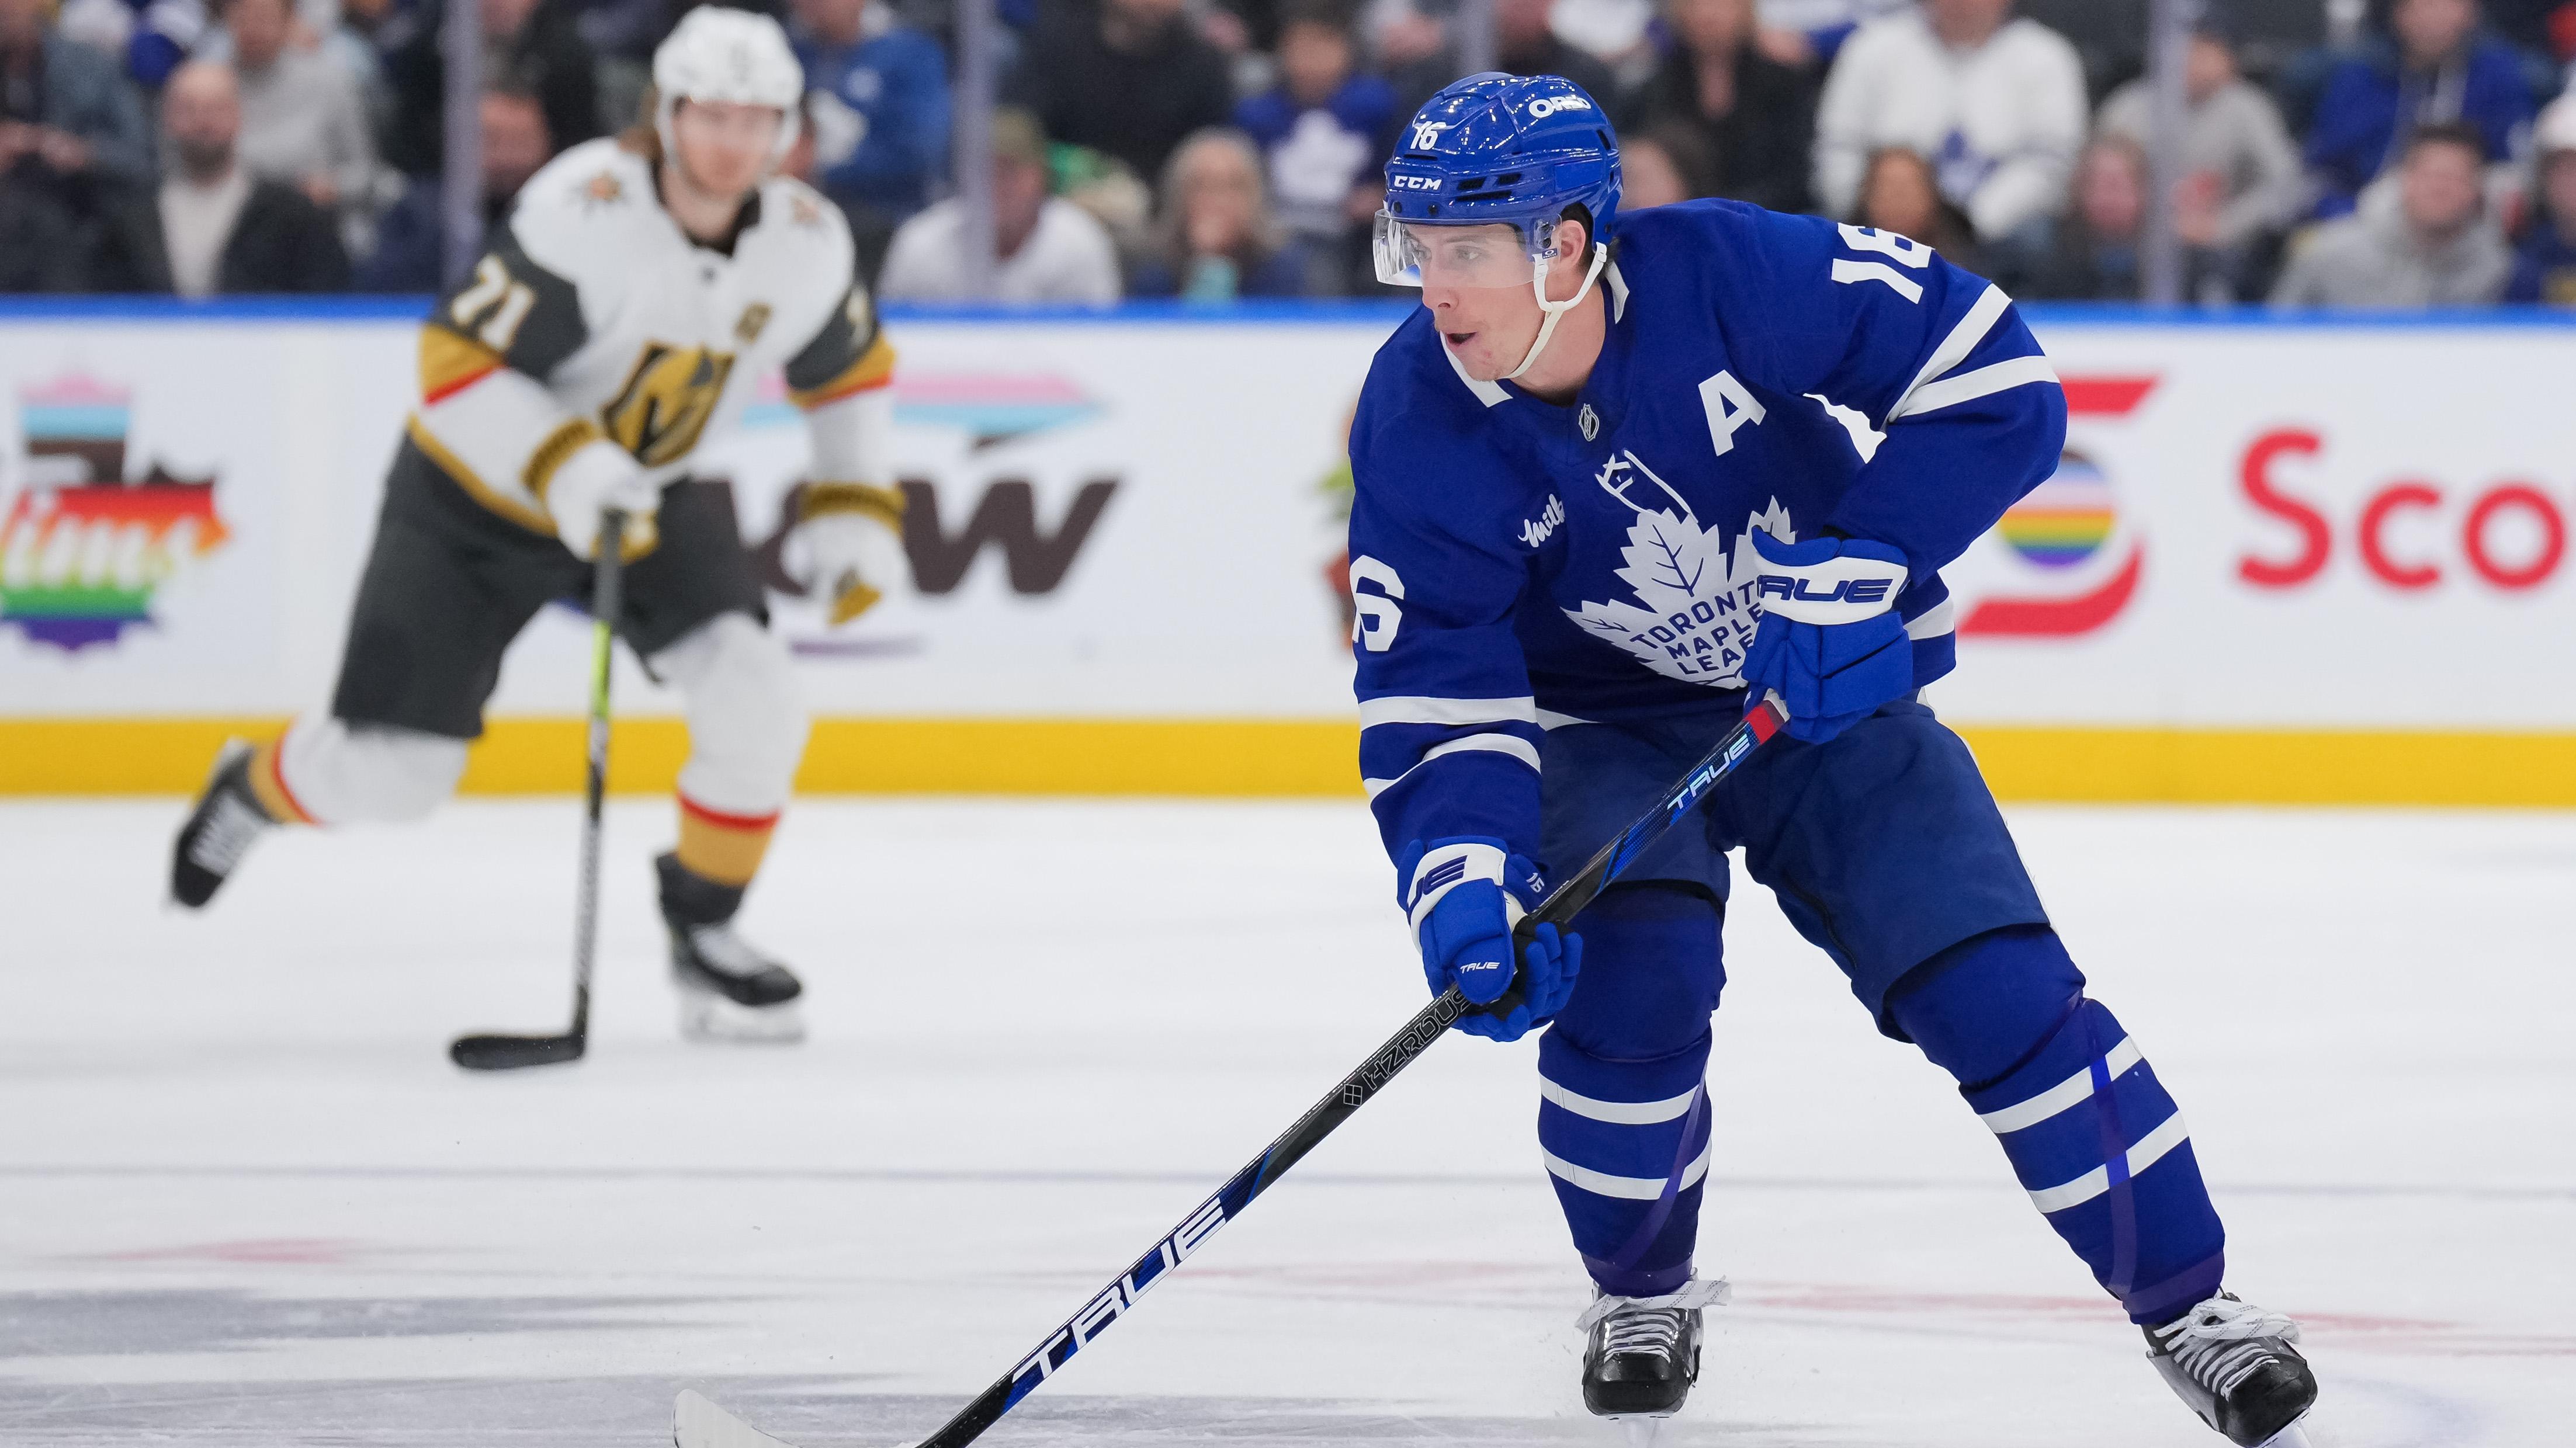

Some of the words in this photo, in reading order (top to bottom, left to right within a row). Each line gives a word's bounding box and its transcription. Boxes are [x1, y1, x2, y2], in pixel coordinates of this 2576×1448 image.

[1410, 120, 1447, 151] 16
[1393, 175, 1443, 190] CCM
[450, 253, 536, 352] 71
[1698, 369, 1767, 457] A
[1349, 554, 1405, 652] 6
[1629, 579, 1755, 650] TORONT
[1756, 574, 1894, 604] RUE
[1665, 602, 1763, 660] MAPLE
[1676, 632, 1755, 675] LEAF
[1666, 733, 1750, 811] TRUE
[1526, 872, 1545, 894] 16
[1459, 961, 1500, 975] TRUE
[1011, 1196, 1227, 1384] TRUE
